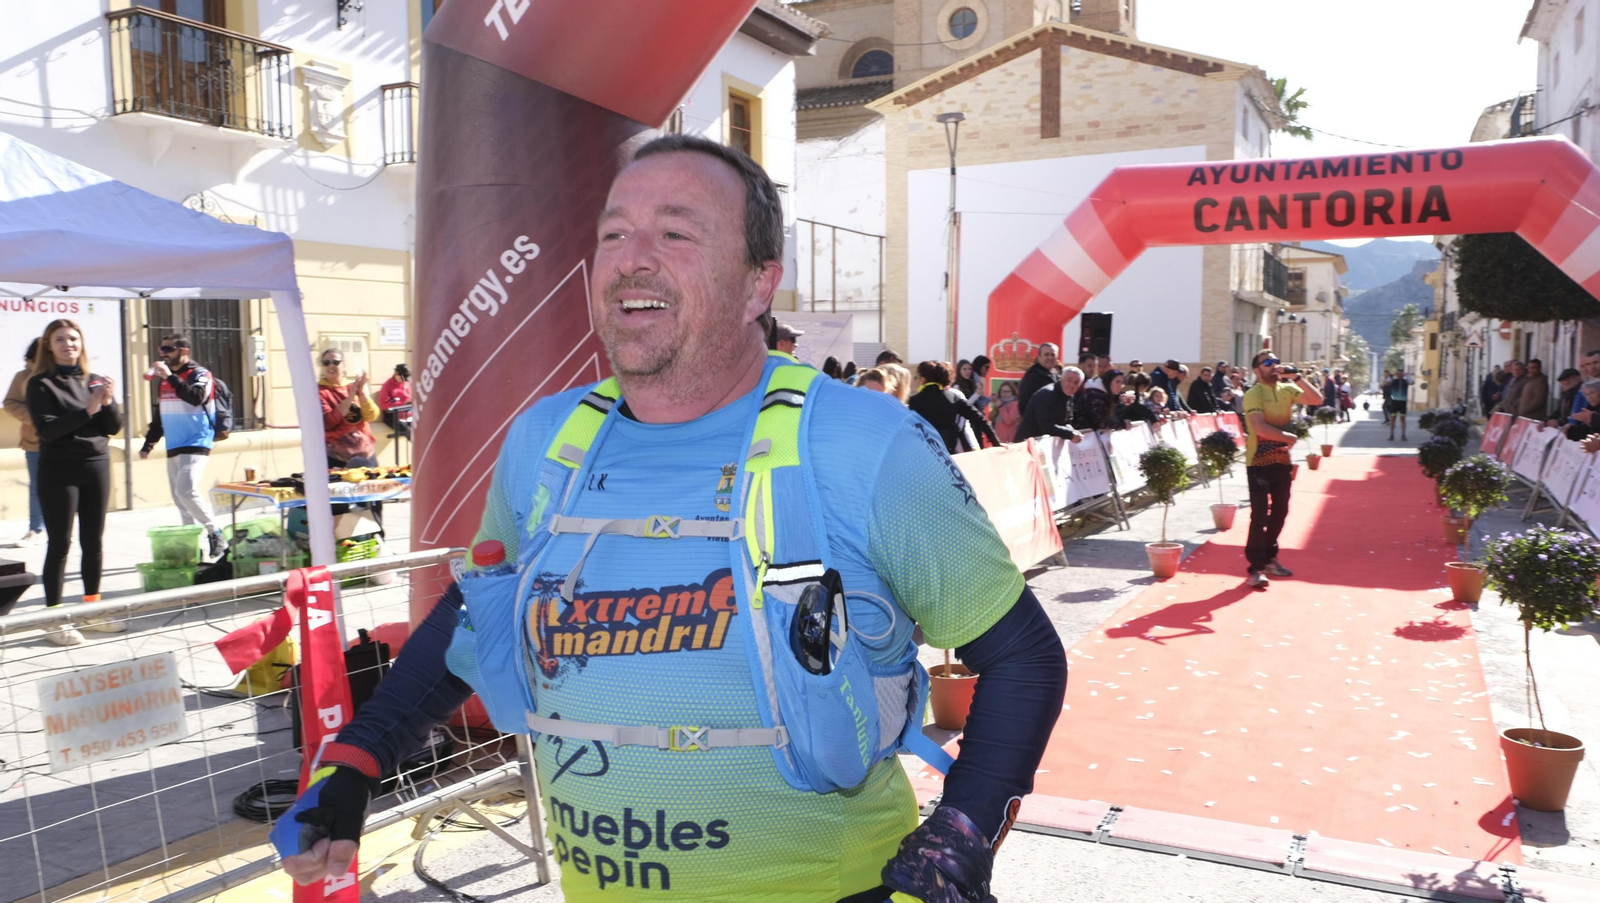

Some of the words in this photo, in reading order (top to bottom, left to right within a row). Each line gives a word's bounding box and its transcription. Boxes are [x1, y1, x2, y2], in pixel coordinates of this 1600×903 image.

[1187, 149, 1464, 187] AYUNTAMIENTO
[1193, 185, 1452, 233] CANTORIA
[553, 610, 731, 656] mandril
[54, 666, 134, 701] ALYSER
[45, 686, 181, 736] MAQUINARIA
[80, 738, 112, 758] 950
[116, 729, 147, 748] 453
[151, 721, 178, 739] 550
[550, 796, 730, 851] muebles
